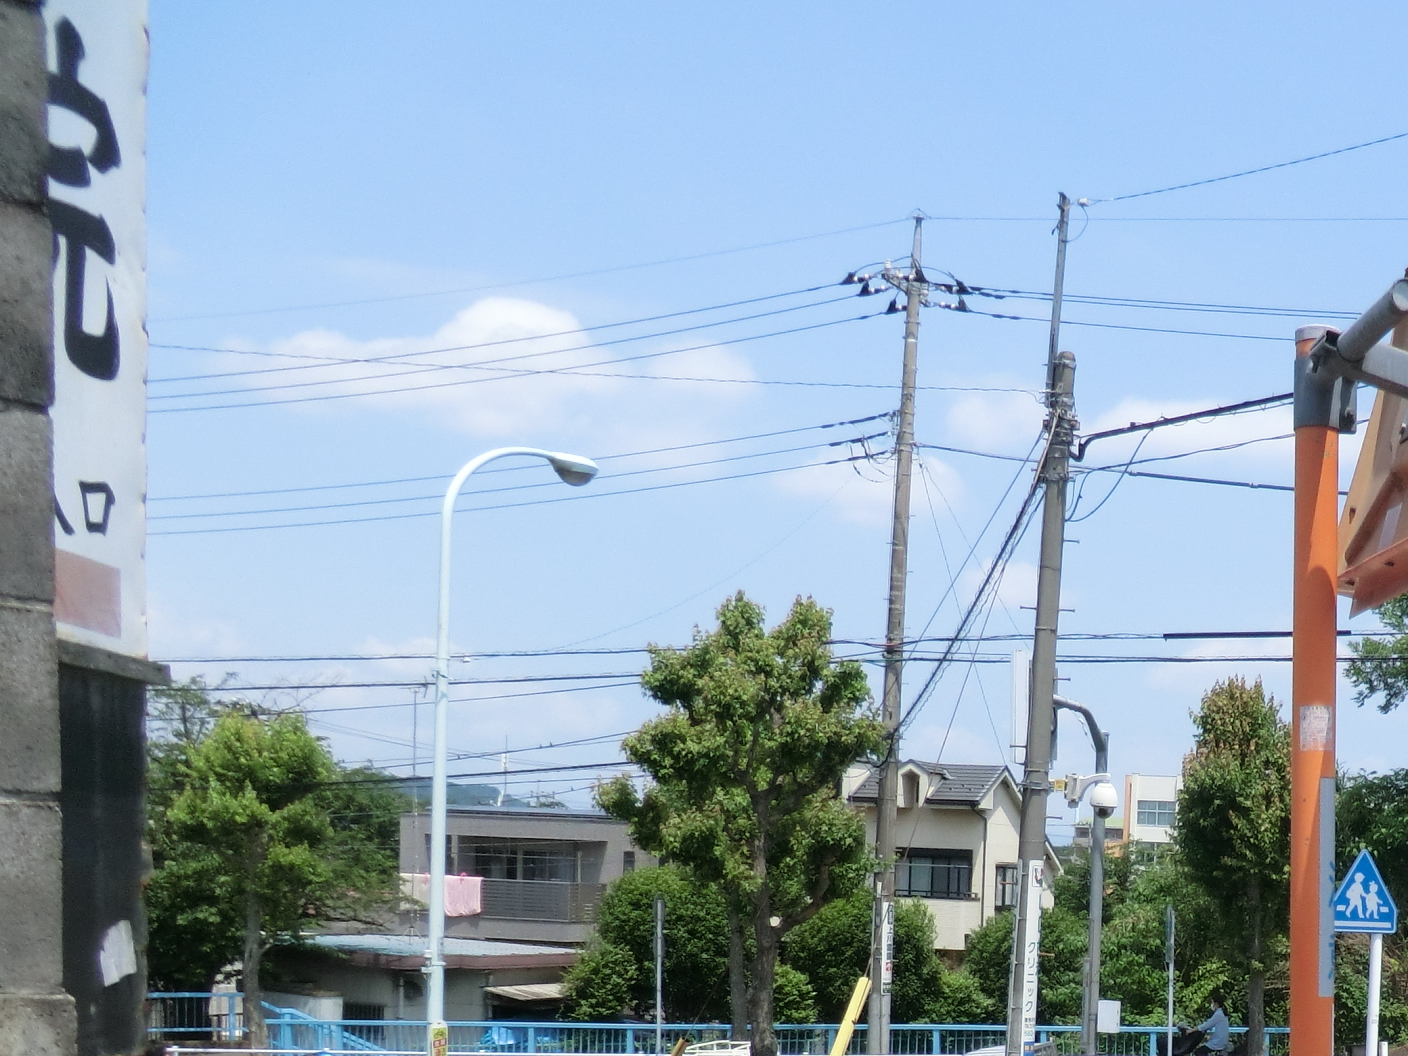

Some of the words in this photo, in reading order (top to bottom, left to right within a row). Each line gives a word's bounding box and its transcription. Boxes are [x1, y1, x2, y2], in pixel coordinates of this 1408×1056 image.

[1025, 942, 1036, 1012] クリニック
